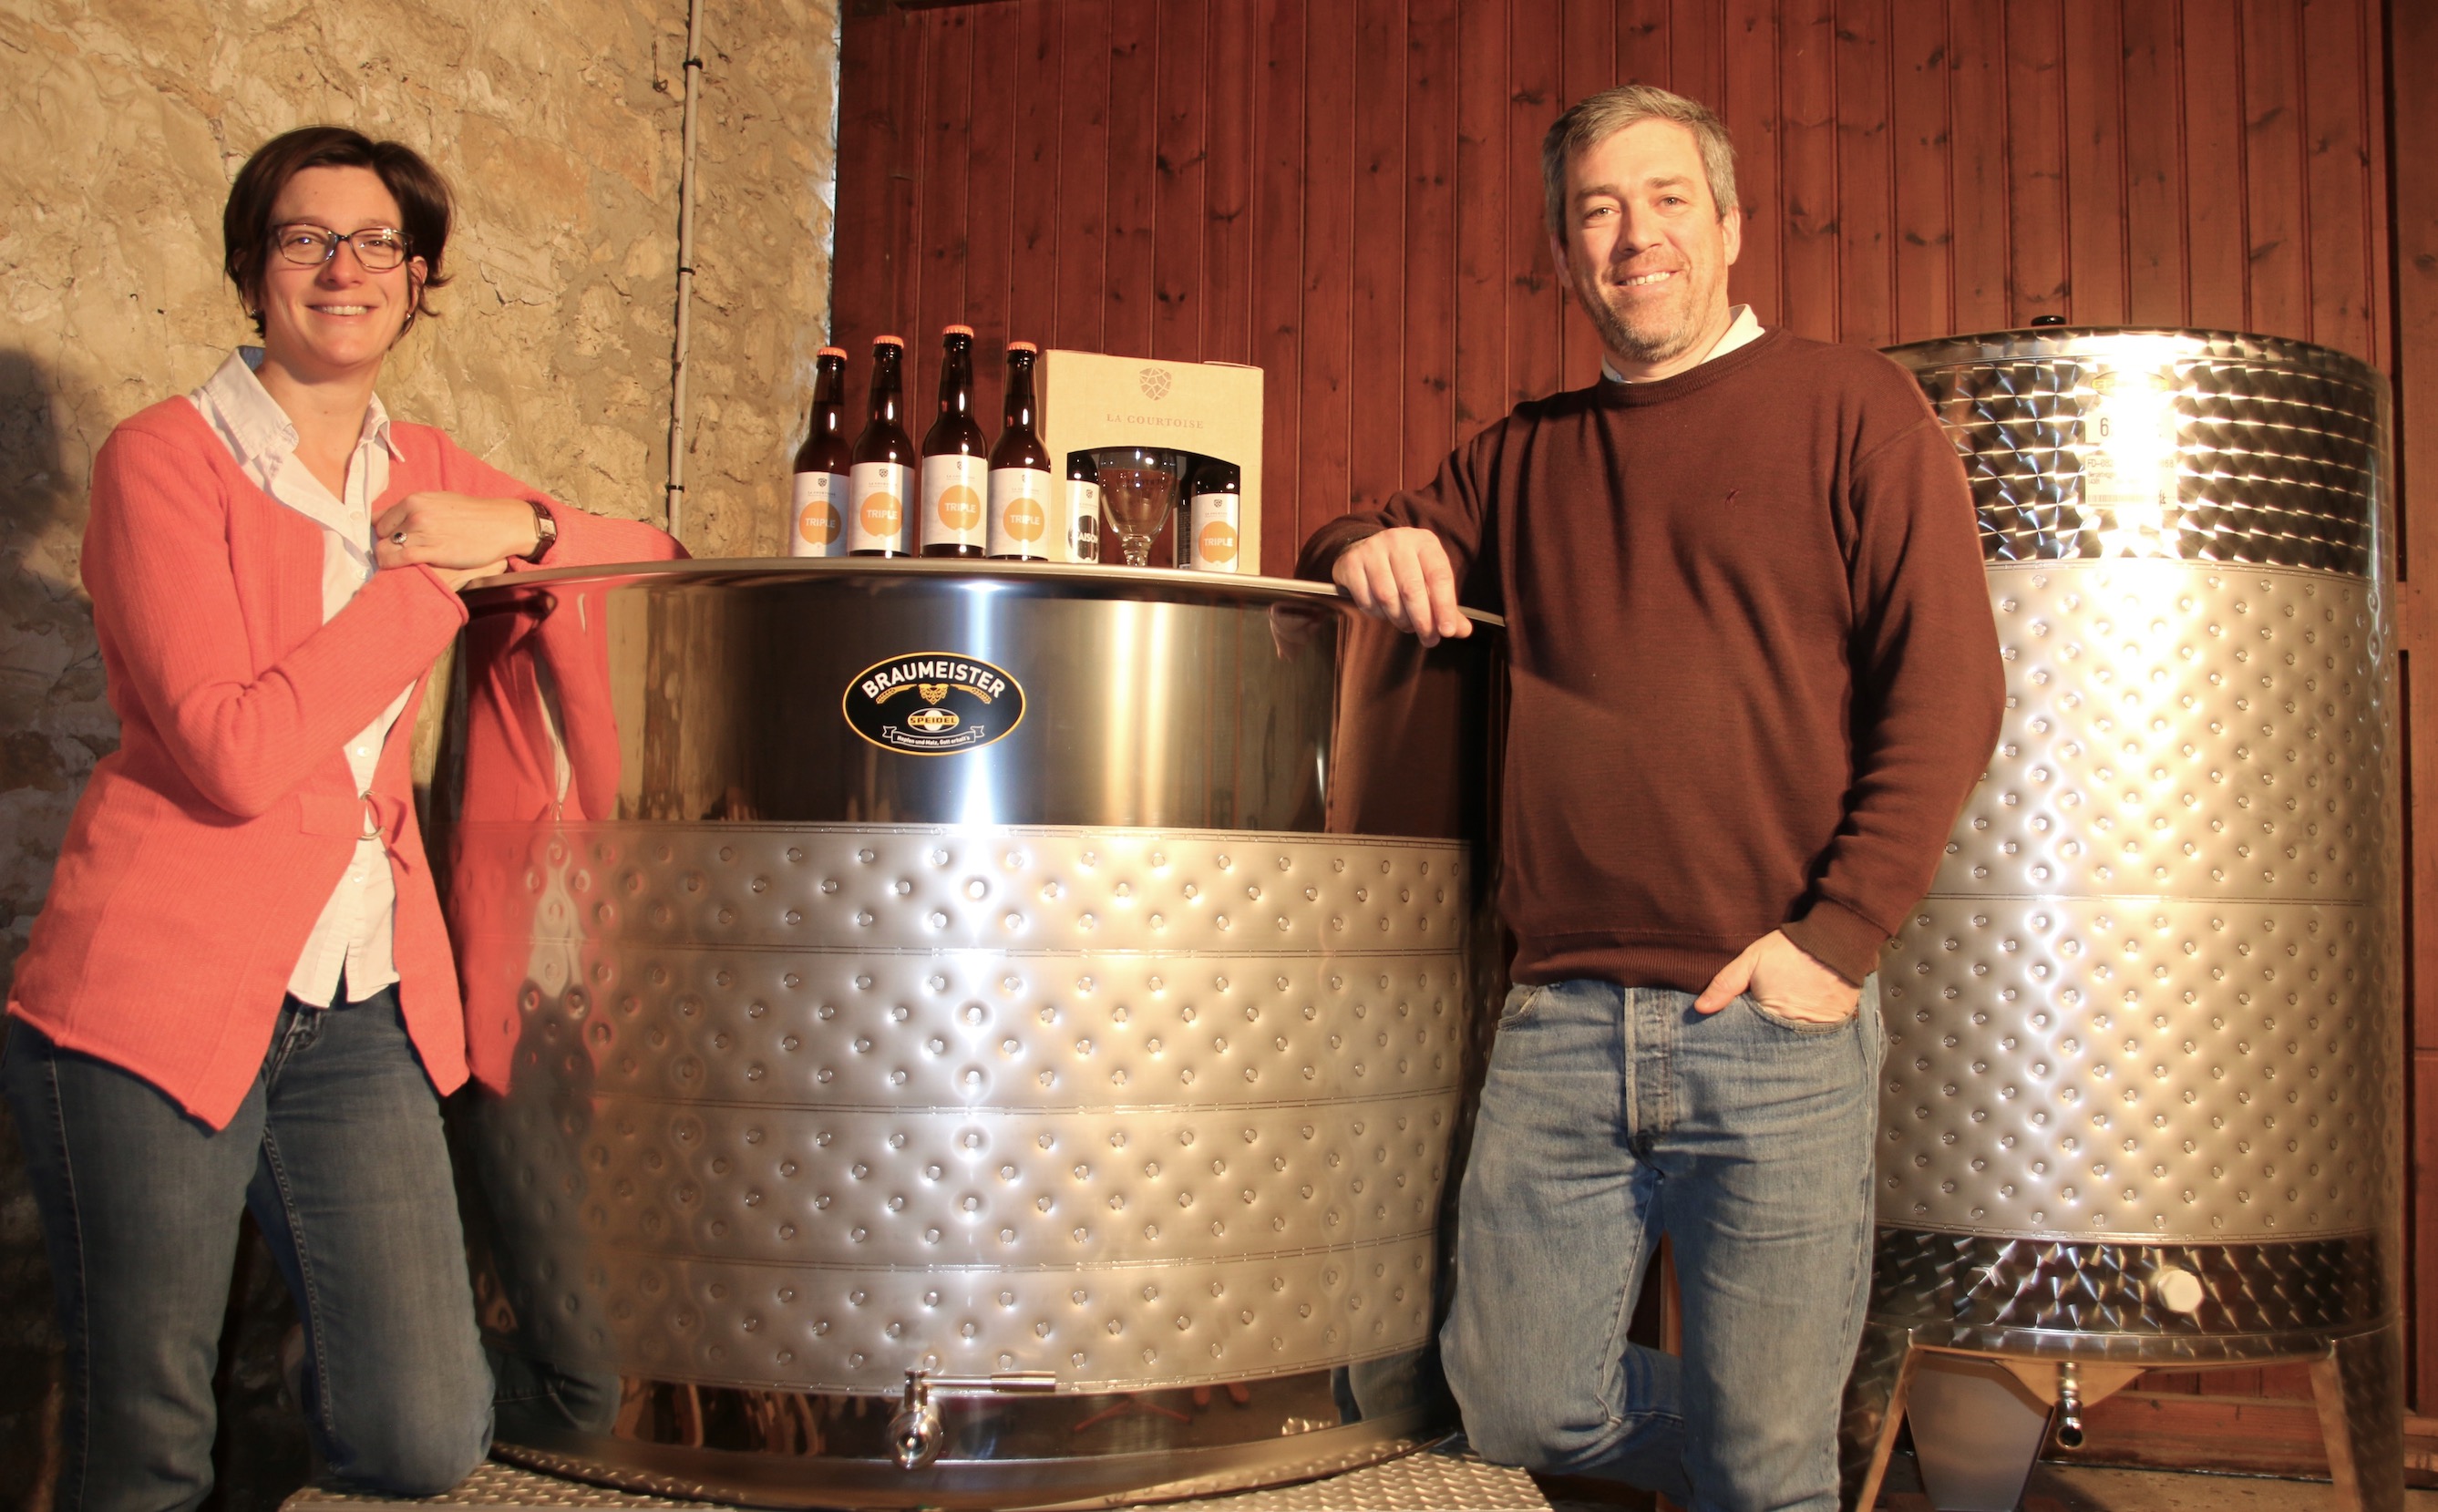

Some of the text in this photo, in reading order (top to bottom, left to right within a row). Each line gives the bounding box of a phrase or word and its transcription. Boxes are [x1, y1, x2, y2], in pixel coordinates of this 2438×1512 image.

[1106, 413, 1204, 429] LA COURTOISE
[944, 502, 976, 514] TRIPLE
[867, 509, 898, 520] TRIPLE
[1010, 514, 1040, 526] TRIPLE
[805, 518, 836, 529] TRIPLE
[1203, 537, 1233, 548] TRIPLE
[861, 661, 1006, 698] BRAUMEISTER
